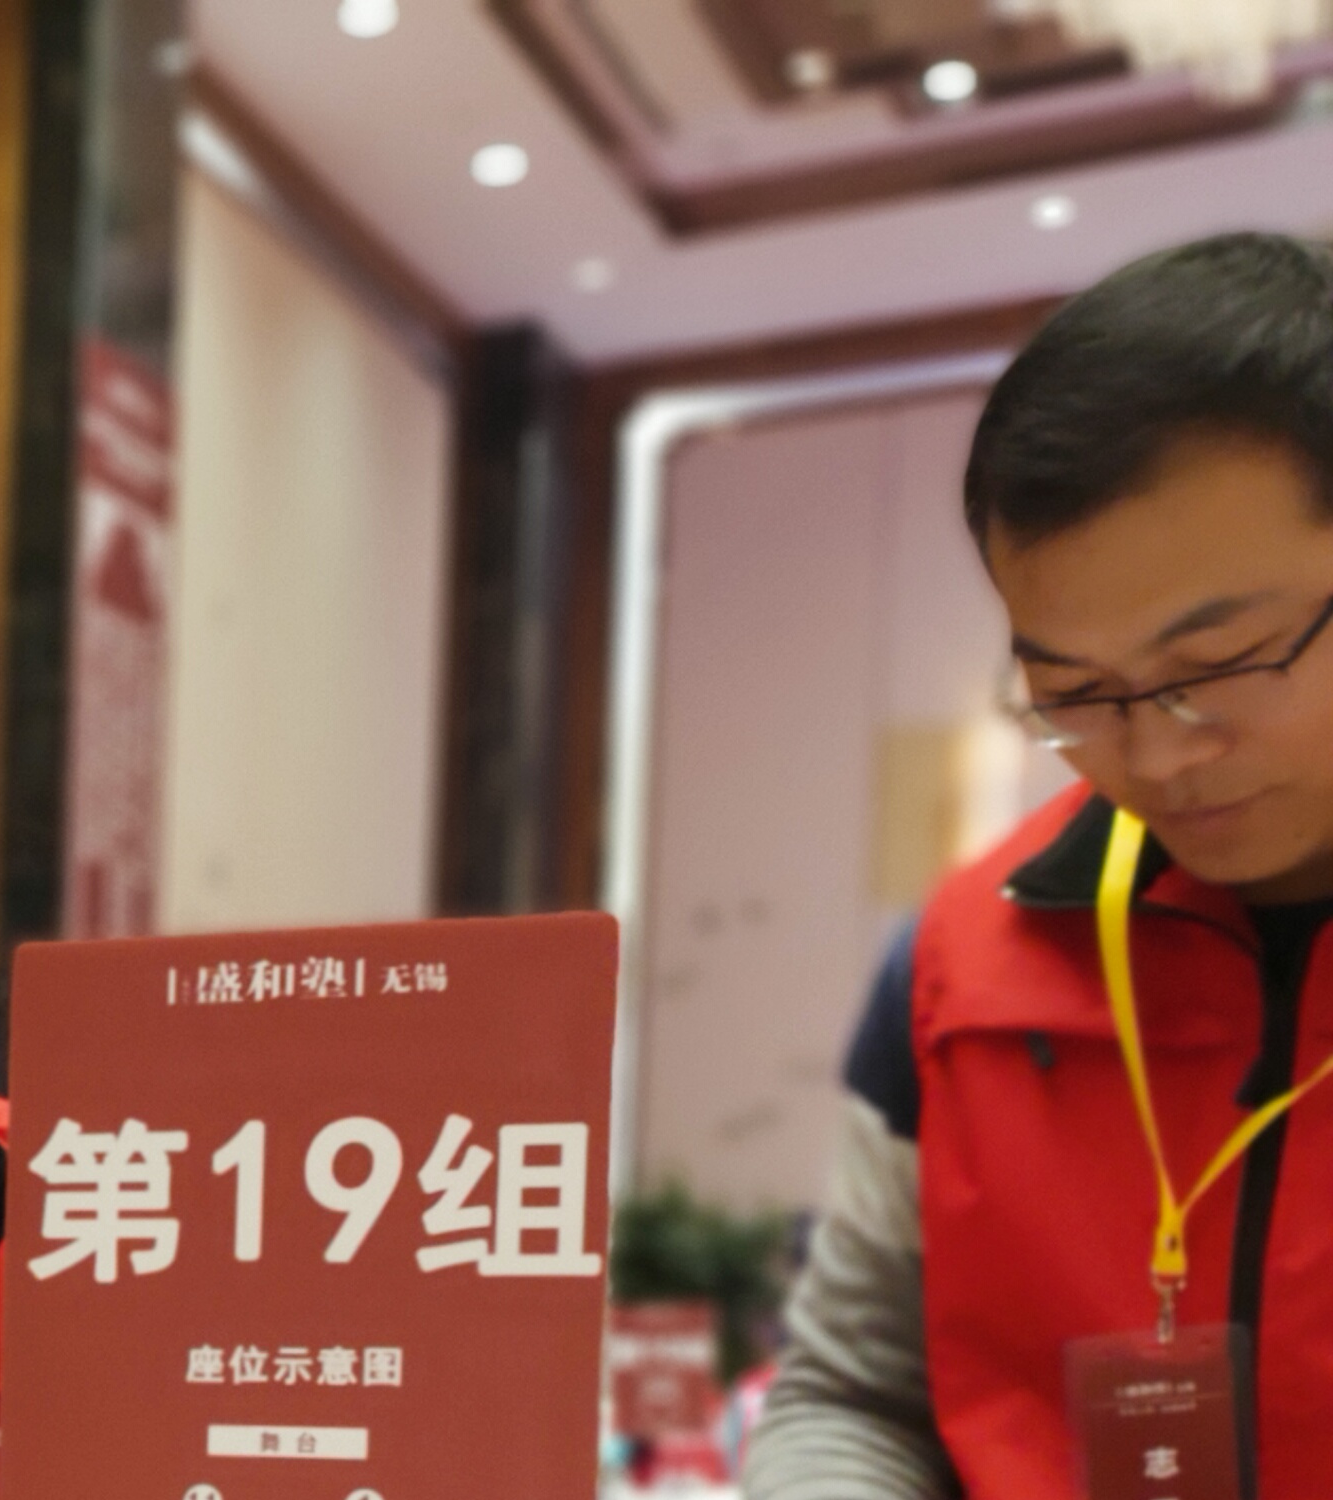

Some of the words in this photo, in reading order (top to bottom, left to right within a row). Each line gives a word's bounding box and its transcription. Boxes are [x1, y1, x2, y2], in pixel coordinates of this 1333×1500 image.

[383, 962, 449, 993] 无锡
[27, 1114, 601, 1283] 第19组
[186, 1345, 403, 1387] 座位示意图
